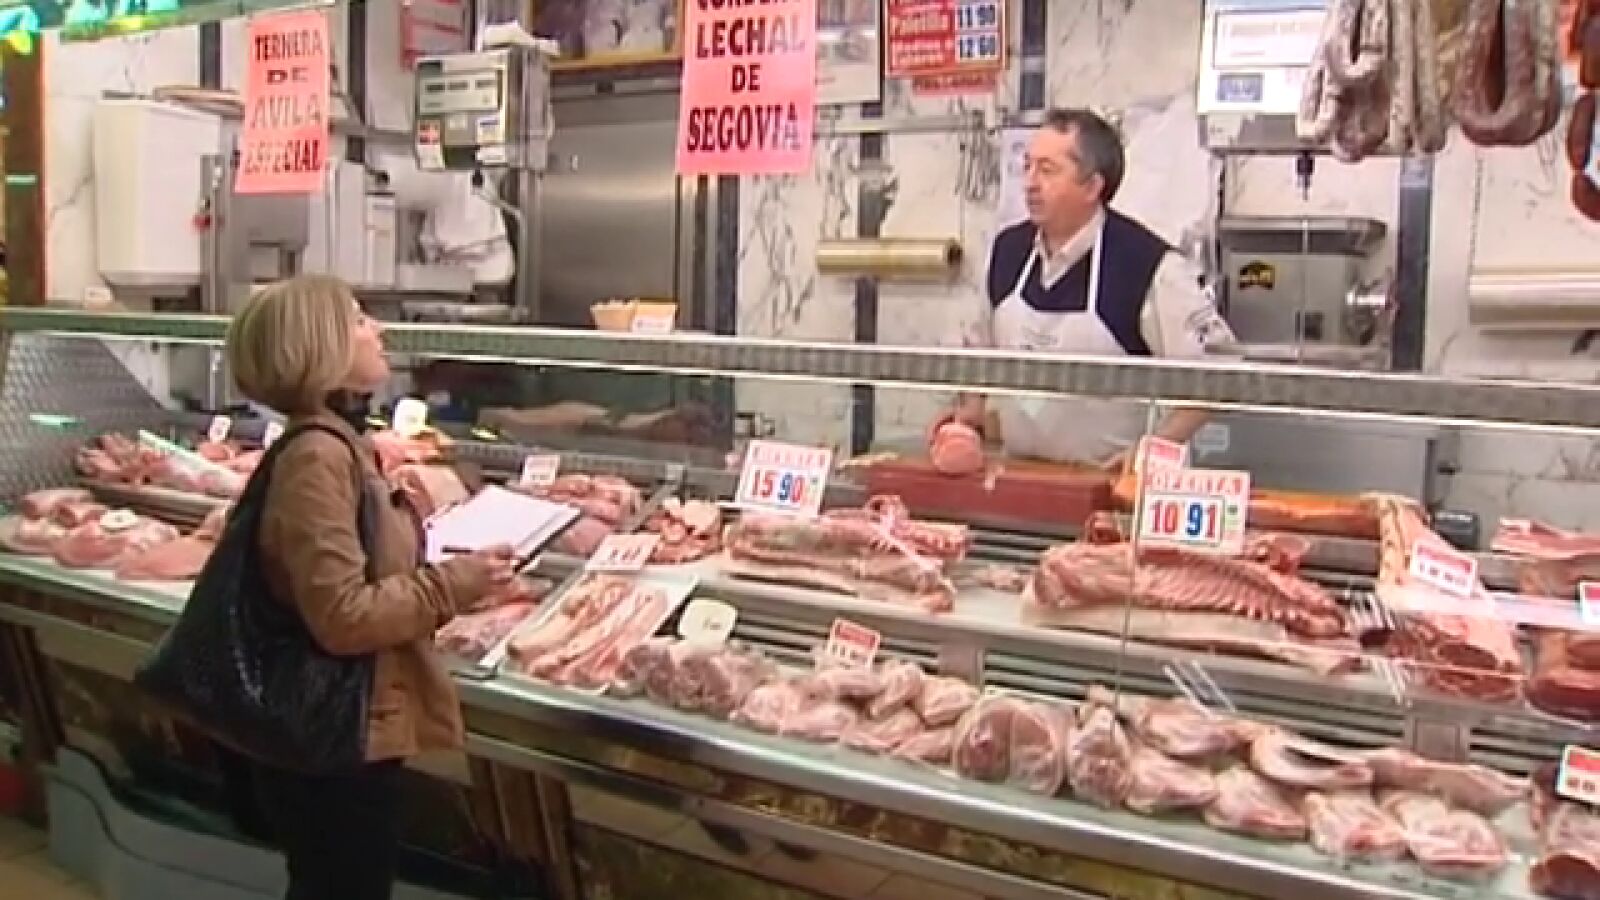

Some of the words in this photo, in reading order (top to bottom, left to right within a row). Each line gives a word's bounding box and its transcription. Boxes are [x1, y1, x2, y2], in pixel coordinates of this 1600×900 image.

[255, 29, 322, 62] TERNERA
[696, 15, 805, 58] LECHAL
[267, 67, 309, 85] DE
[731, 62, 761, 92] DE
[252, 94, 321, 128] AVILA
[687, 102, 802, 152] SEGOVIA
